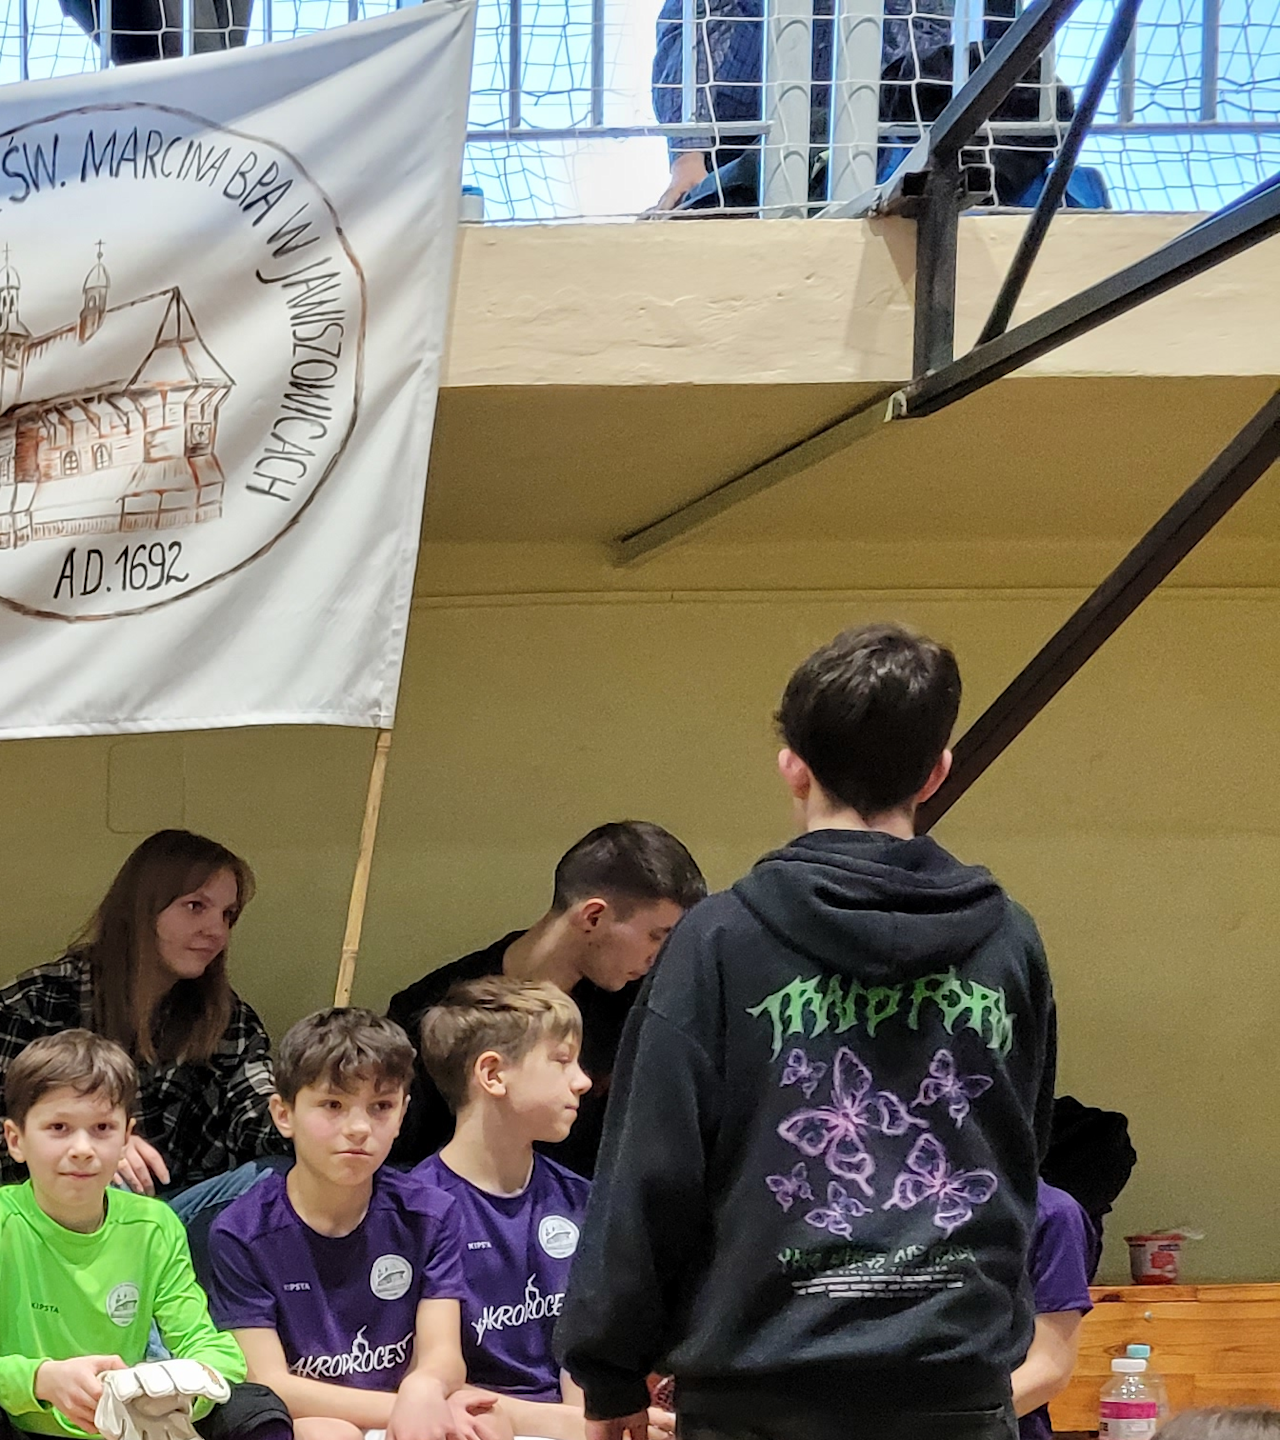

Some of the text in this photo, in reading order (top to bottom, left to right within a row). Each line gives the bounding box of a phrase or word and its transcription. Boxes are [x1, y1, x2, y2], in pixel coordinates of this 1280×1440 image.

[2, 133, 66, 204] ŚW.
[80, 127, 231, 187] MARCINA
[223, 151, 294, 227] BPA
[266, 202, 320, 258] W
[246, 257, 345, 501] JAWISZOWICACH
[467, 1241, 492, 1250] KIPSTA
[31, 1302, 59, 1314] KIPSTA
